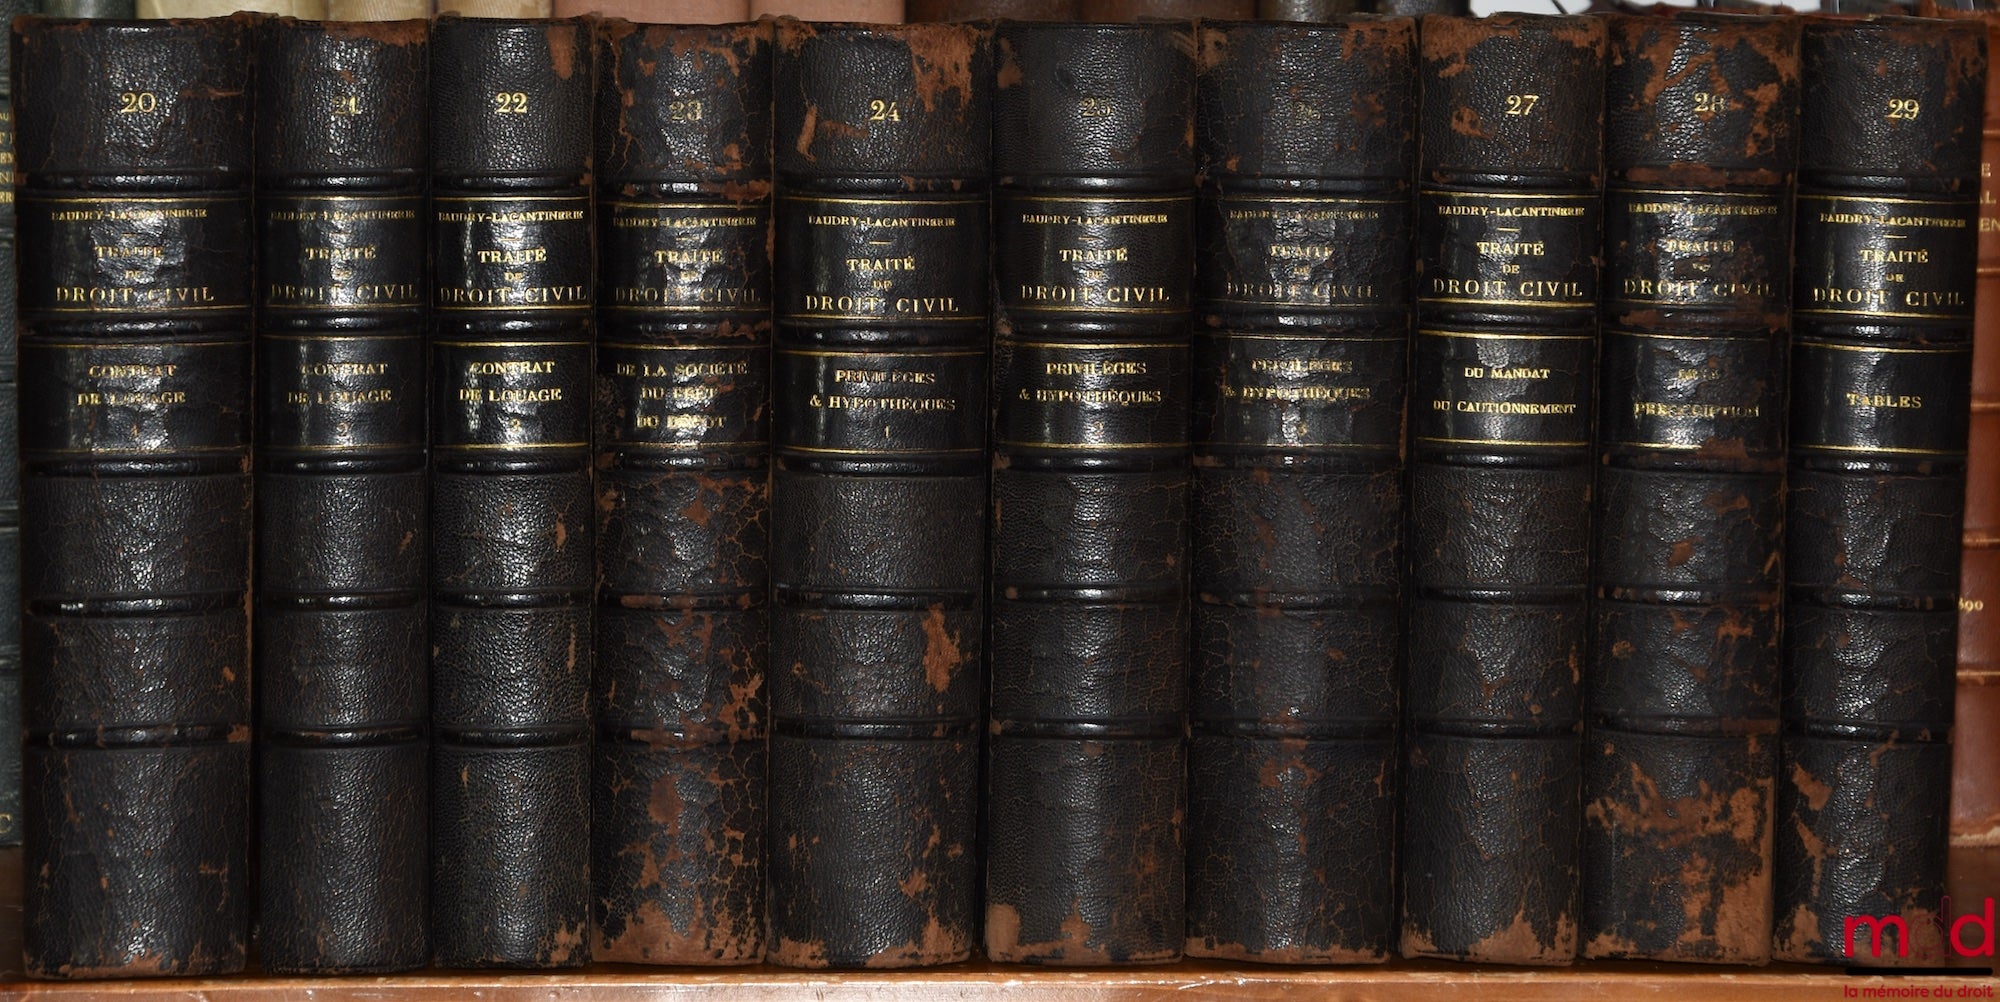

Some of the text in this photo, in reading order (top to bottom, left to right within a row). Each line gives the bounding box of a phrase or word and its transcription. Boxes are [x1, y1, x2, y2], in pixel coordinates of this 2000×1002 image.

[121, 92, 156, 113] 20
[332, 96, 362, 115] 21
[496, 92, 528, 113] 22
[870, 99, 900, 121] 24
[1506, 94, 1539, 115] 27
[1693, 92, 1725, 113] 28
[1888, 99, 1920, 121] 29
[669, 100, 702, 121] 23
[438, 210, 583, 222] BAUDRY-LACANTINERIE
[1439, 206, 1584, 217] BAUDRY-LACANTINERIE
[808, 215, 956, 228] BAUDRY-LACANTINERIE
[478, 246, 547, 264] TRAITÉ
[1059, 247, 1128, 262] TRAITÉ
[1476, 241, 1545, 256] TRAITÉ
[846, 255, 915, 271] TRAITÉ
[1860, 249, 1929, 264] TRAITÉ
[505, 272, 523, 281] DE
[1502, 264, 1520, 274] DE
[56, 287, 214, 303] DROIT CIVIL
[271, 283, 418, 300] DROIT CIVIL
[440, 285, 587, 303] DROIT CIVIL
[1021, 285, 1170, 303] DROIT CIVIL
[1227, 282, 1379, 299] DROIT CIVIL
[1433, 278, 1583, 297] DROIT CIVIL
[1623, 279, 1775, 297] DROIT CIVIL
[615, 287, 761, 305] DROIT CIVIL
[1812, 288, 1964, 307] DROIT CIVIL
[805, 295, 959, 313] DROIT CIVIL
[89, 364, 177, 379] CONTRAT
[301, 362, 388, 375] CONTRAT
[470, 361, 555, 374] CONTRAT
[616, 363, 636, 376] DE
[643, 364, 667, 377] LA
[1046, 361, 1147, 375] PRIVILÈGES
[1464, 367, 1550, 380] DU MANDAT
[77, 392, 100, 406] DE
[288, 389, 392, 404] DE LOUAGE
[459, 388, 562, 402] DE LOUAGE
[641, 387, 665, 400] DU
[810, 394, 822, 408] &
[1019, 388, 1031, 401] &
[1846, 393, 1922, 409] TABLES
[1433, 400, 1576, 415] DU CAUTIONNEMENT
